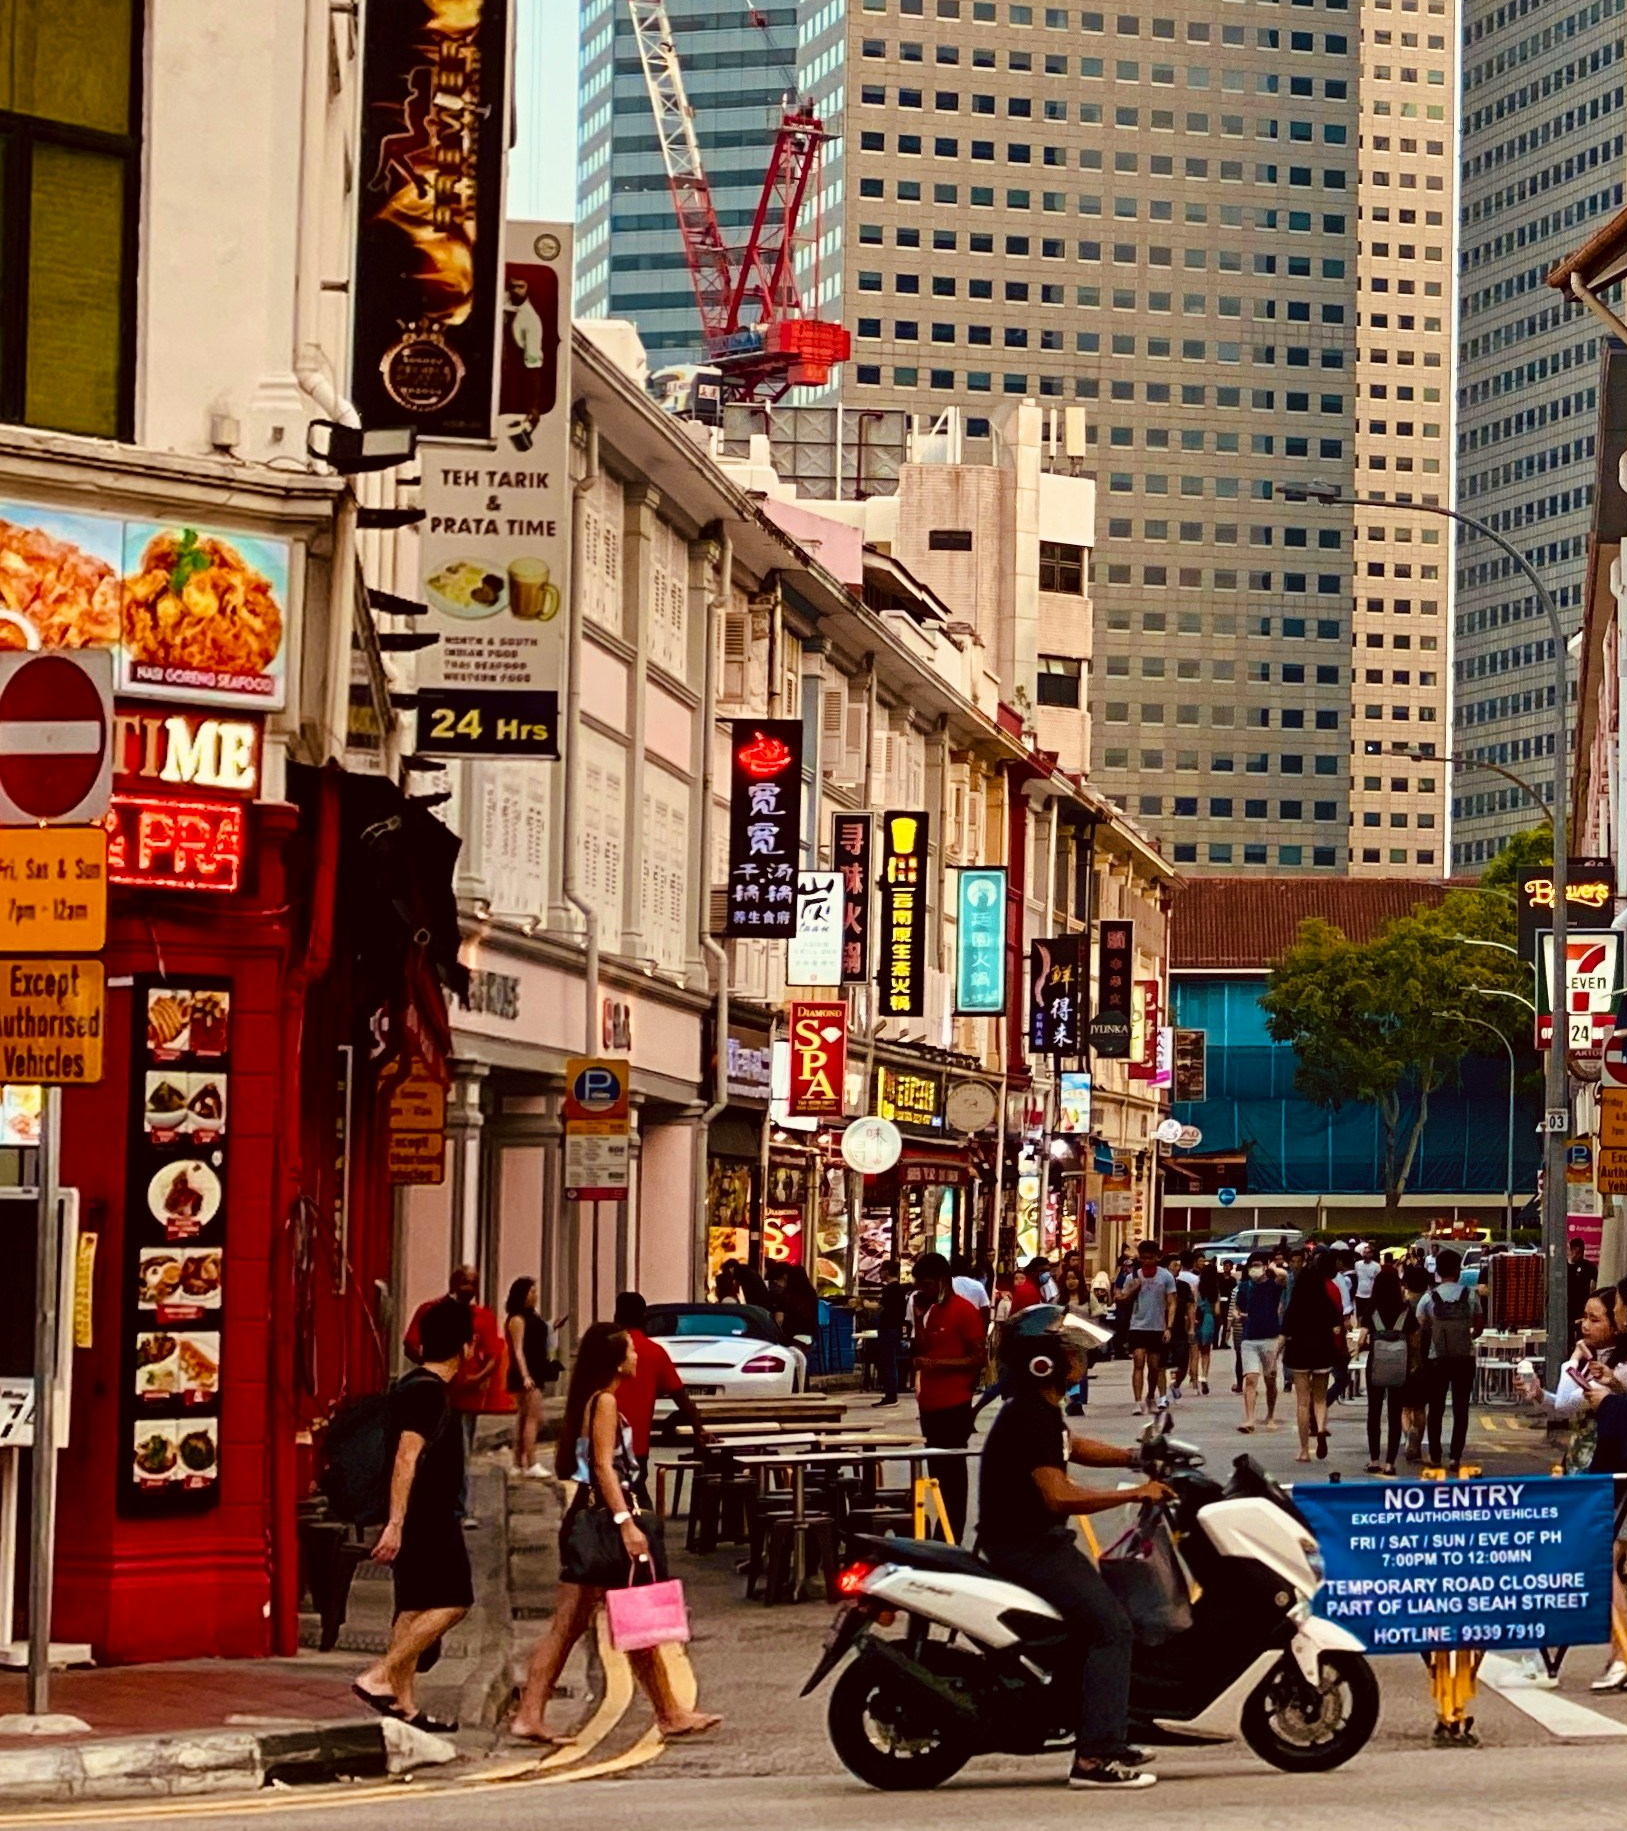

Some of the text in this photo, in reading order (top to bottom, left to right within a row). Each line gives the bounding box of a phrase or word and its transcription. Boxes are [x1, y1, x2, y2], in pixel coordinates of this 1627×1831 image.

[441, 469, 550, 489] TEH TARIK
[486, 495, 502, 511] &
[430, 517, 557, 537] PRATA TIME
[430, 707, 549, 741] 24 Hrs
[113, 716, 256, 790] TIME
[25, 858, 49, 880] Sat
[57, 858, 67, 880] &
[75, 858, 102, 880] Sun
[7, 898, 36, 926] 7pm
[53, 898, 88, 920] 12am
[10, 964, 80, 1005] Except
[797, 1006, 842, 1018] DIAMOND
[1571, 1025, 1590, 1043] 24
[4, 1045, 85, 1079] Vehicles
[794, 1019, 840, 1100] SPA
[1549, 1114, 1564, 1129] 03
[1384, 1484, 1526, 1510] NO ENTRY
[1351, 1507, 1559, 1525] EXCEPT AUTHORISED VEHICLES
[1350, 1536, 1376, 1551] FRI
[1388, 1534, 1419, 1549] SAT
[1432, 1533, 1466, 1548] SUN
[1478, 1531, 1510, 1546] EVE
[1514, 1530, 1536, 1545] OF
[1539, 1529, 1562, 1544] PH
[1381, 1549, 1532, 1567] 7:00PM TO 12:00MN
[1326, 1572, 1586, 1596] TEMPORARY ROAD CLOSURE
[1326, 1592, 1590, 1616] PART OF LIANG SEAH STREET
[1373, 1622, 1546, 1645] HOTLINE: 9339 7919
